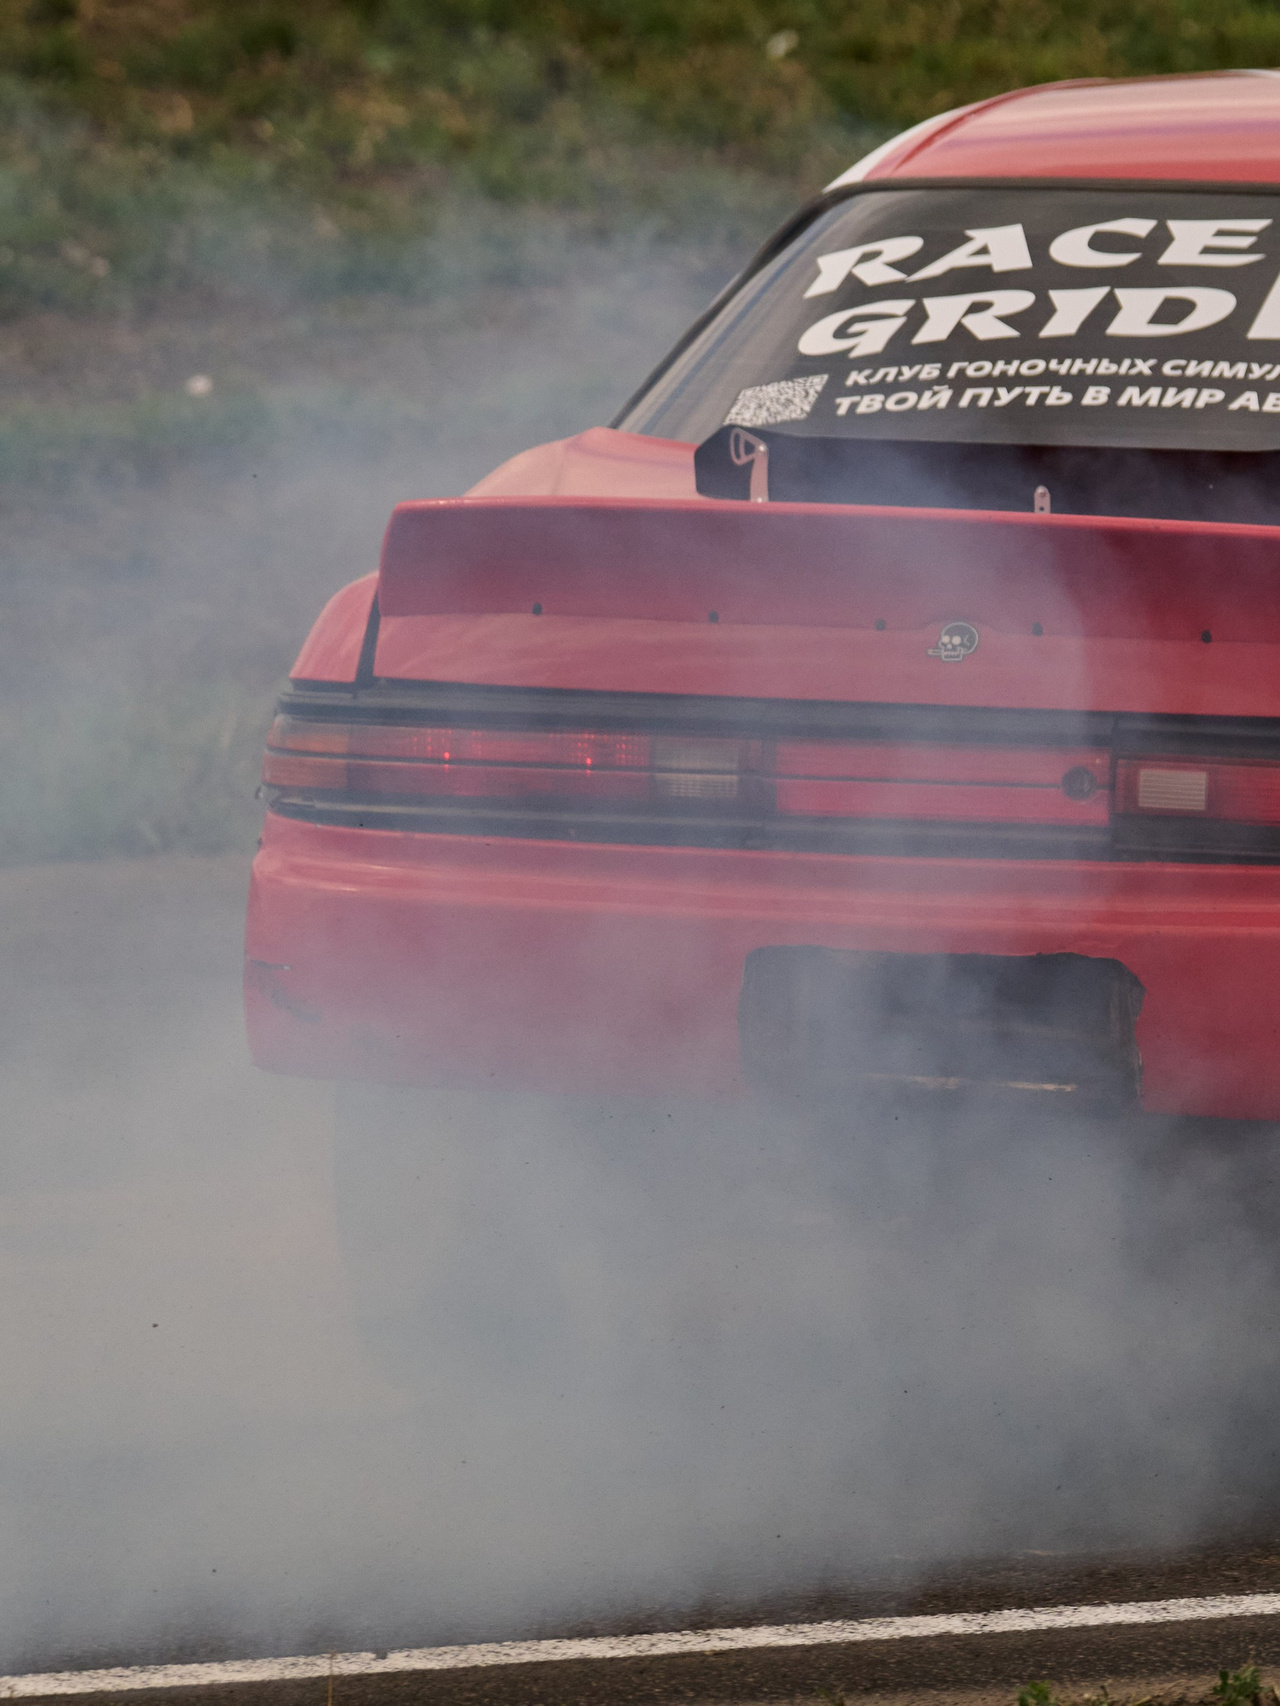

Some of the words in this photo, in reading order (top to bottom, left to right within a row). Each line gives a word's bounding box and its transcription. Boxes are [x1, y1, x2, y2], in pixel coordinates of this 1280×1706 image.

[802, 217, 1273, 300] RACE
[798, 286, 1238, 359] GRID
[845, 362, 942, 387] КЛУБ
[946, 357, 1159, 380] ГОНОЧНЫХ
[834, 384, 955, 417] ТВОЙ
[958, 385, 1074, 409] ПУТЬ
[1080, 385, 1111, 407] В
[1115, 386, 1226, 410] МИР
